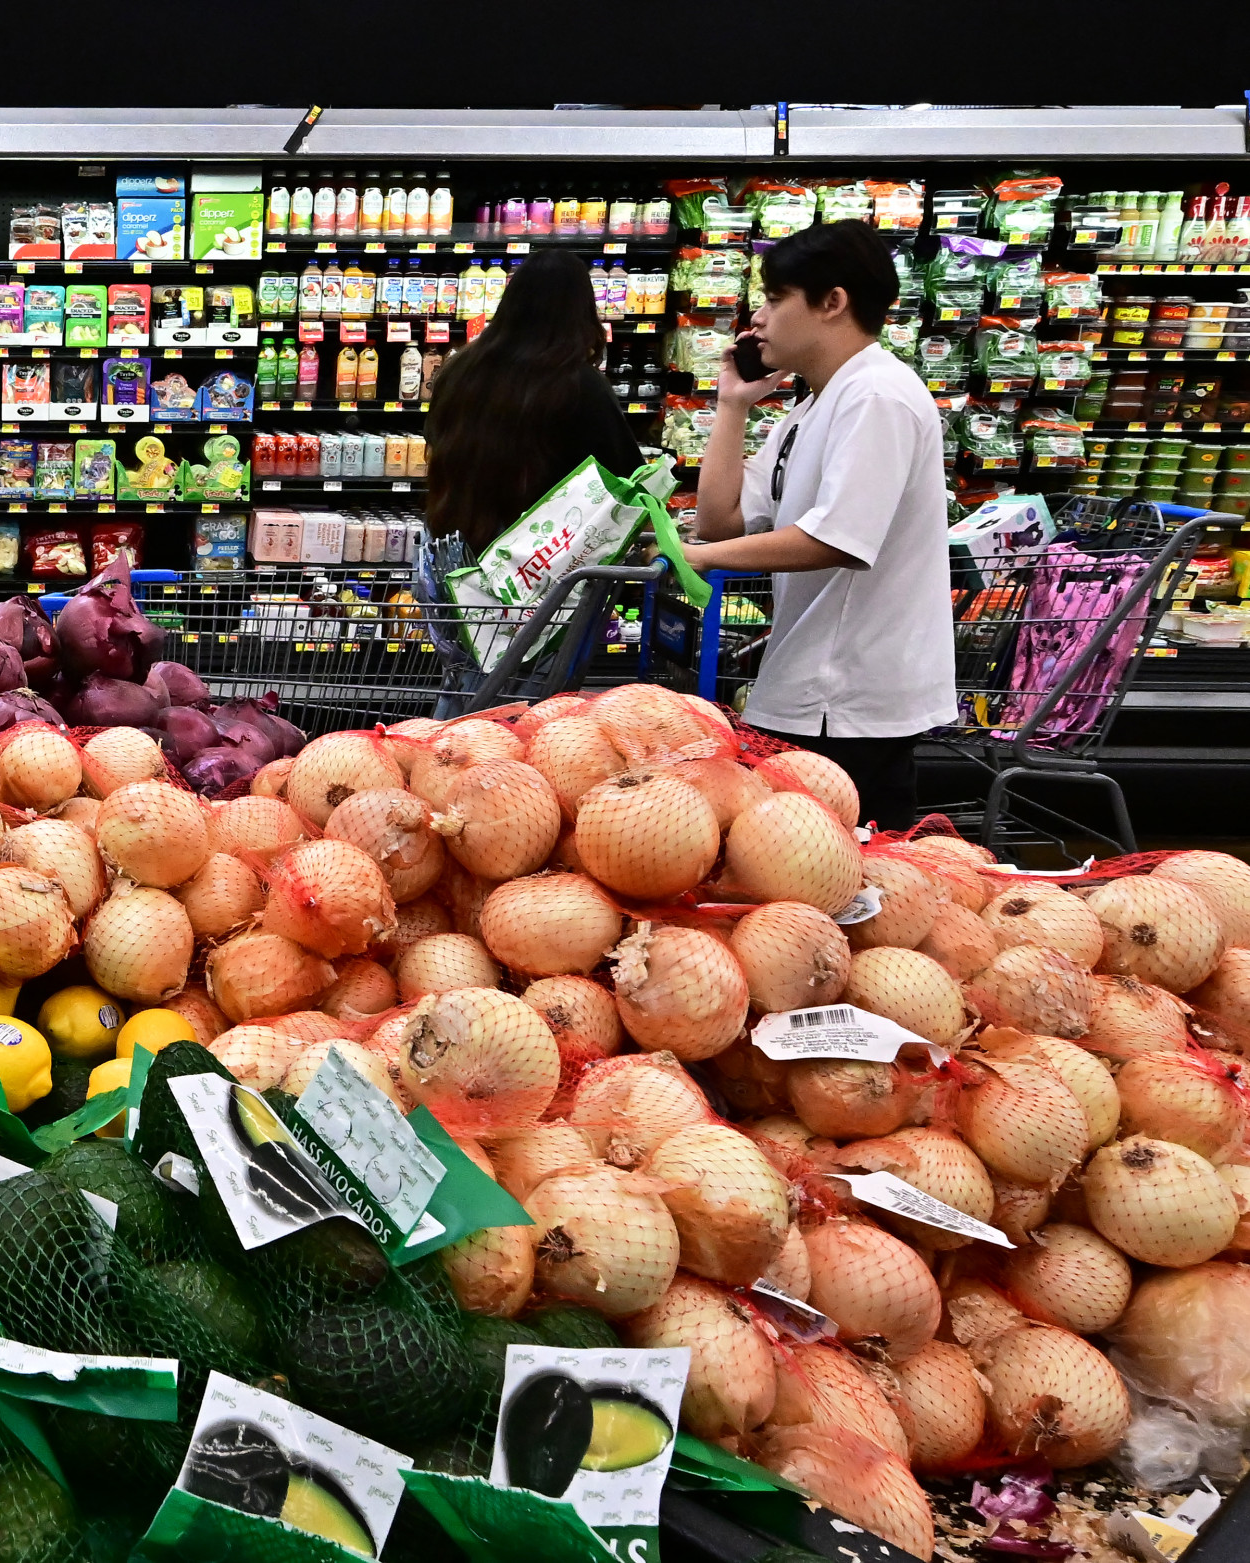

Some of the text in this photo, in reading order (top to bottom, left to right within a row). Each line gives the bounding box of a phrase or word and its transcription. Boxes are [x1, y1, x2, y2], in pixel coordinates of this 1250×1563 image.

[122, 212, 157, 223] dipperz
[199, 208, 235, 219] dipperz
[255, 442, 276, 452] OLIPO
[279, 442, 299, 452] OLIPO
[299, 442, 319, 452] OLIPO
[292, 1122, 392, 1245] HASS AVOCADOS
